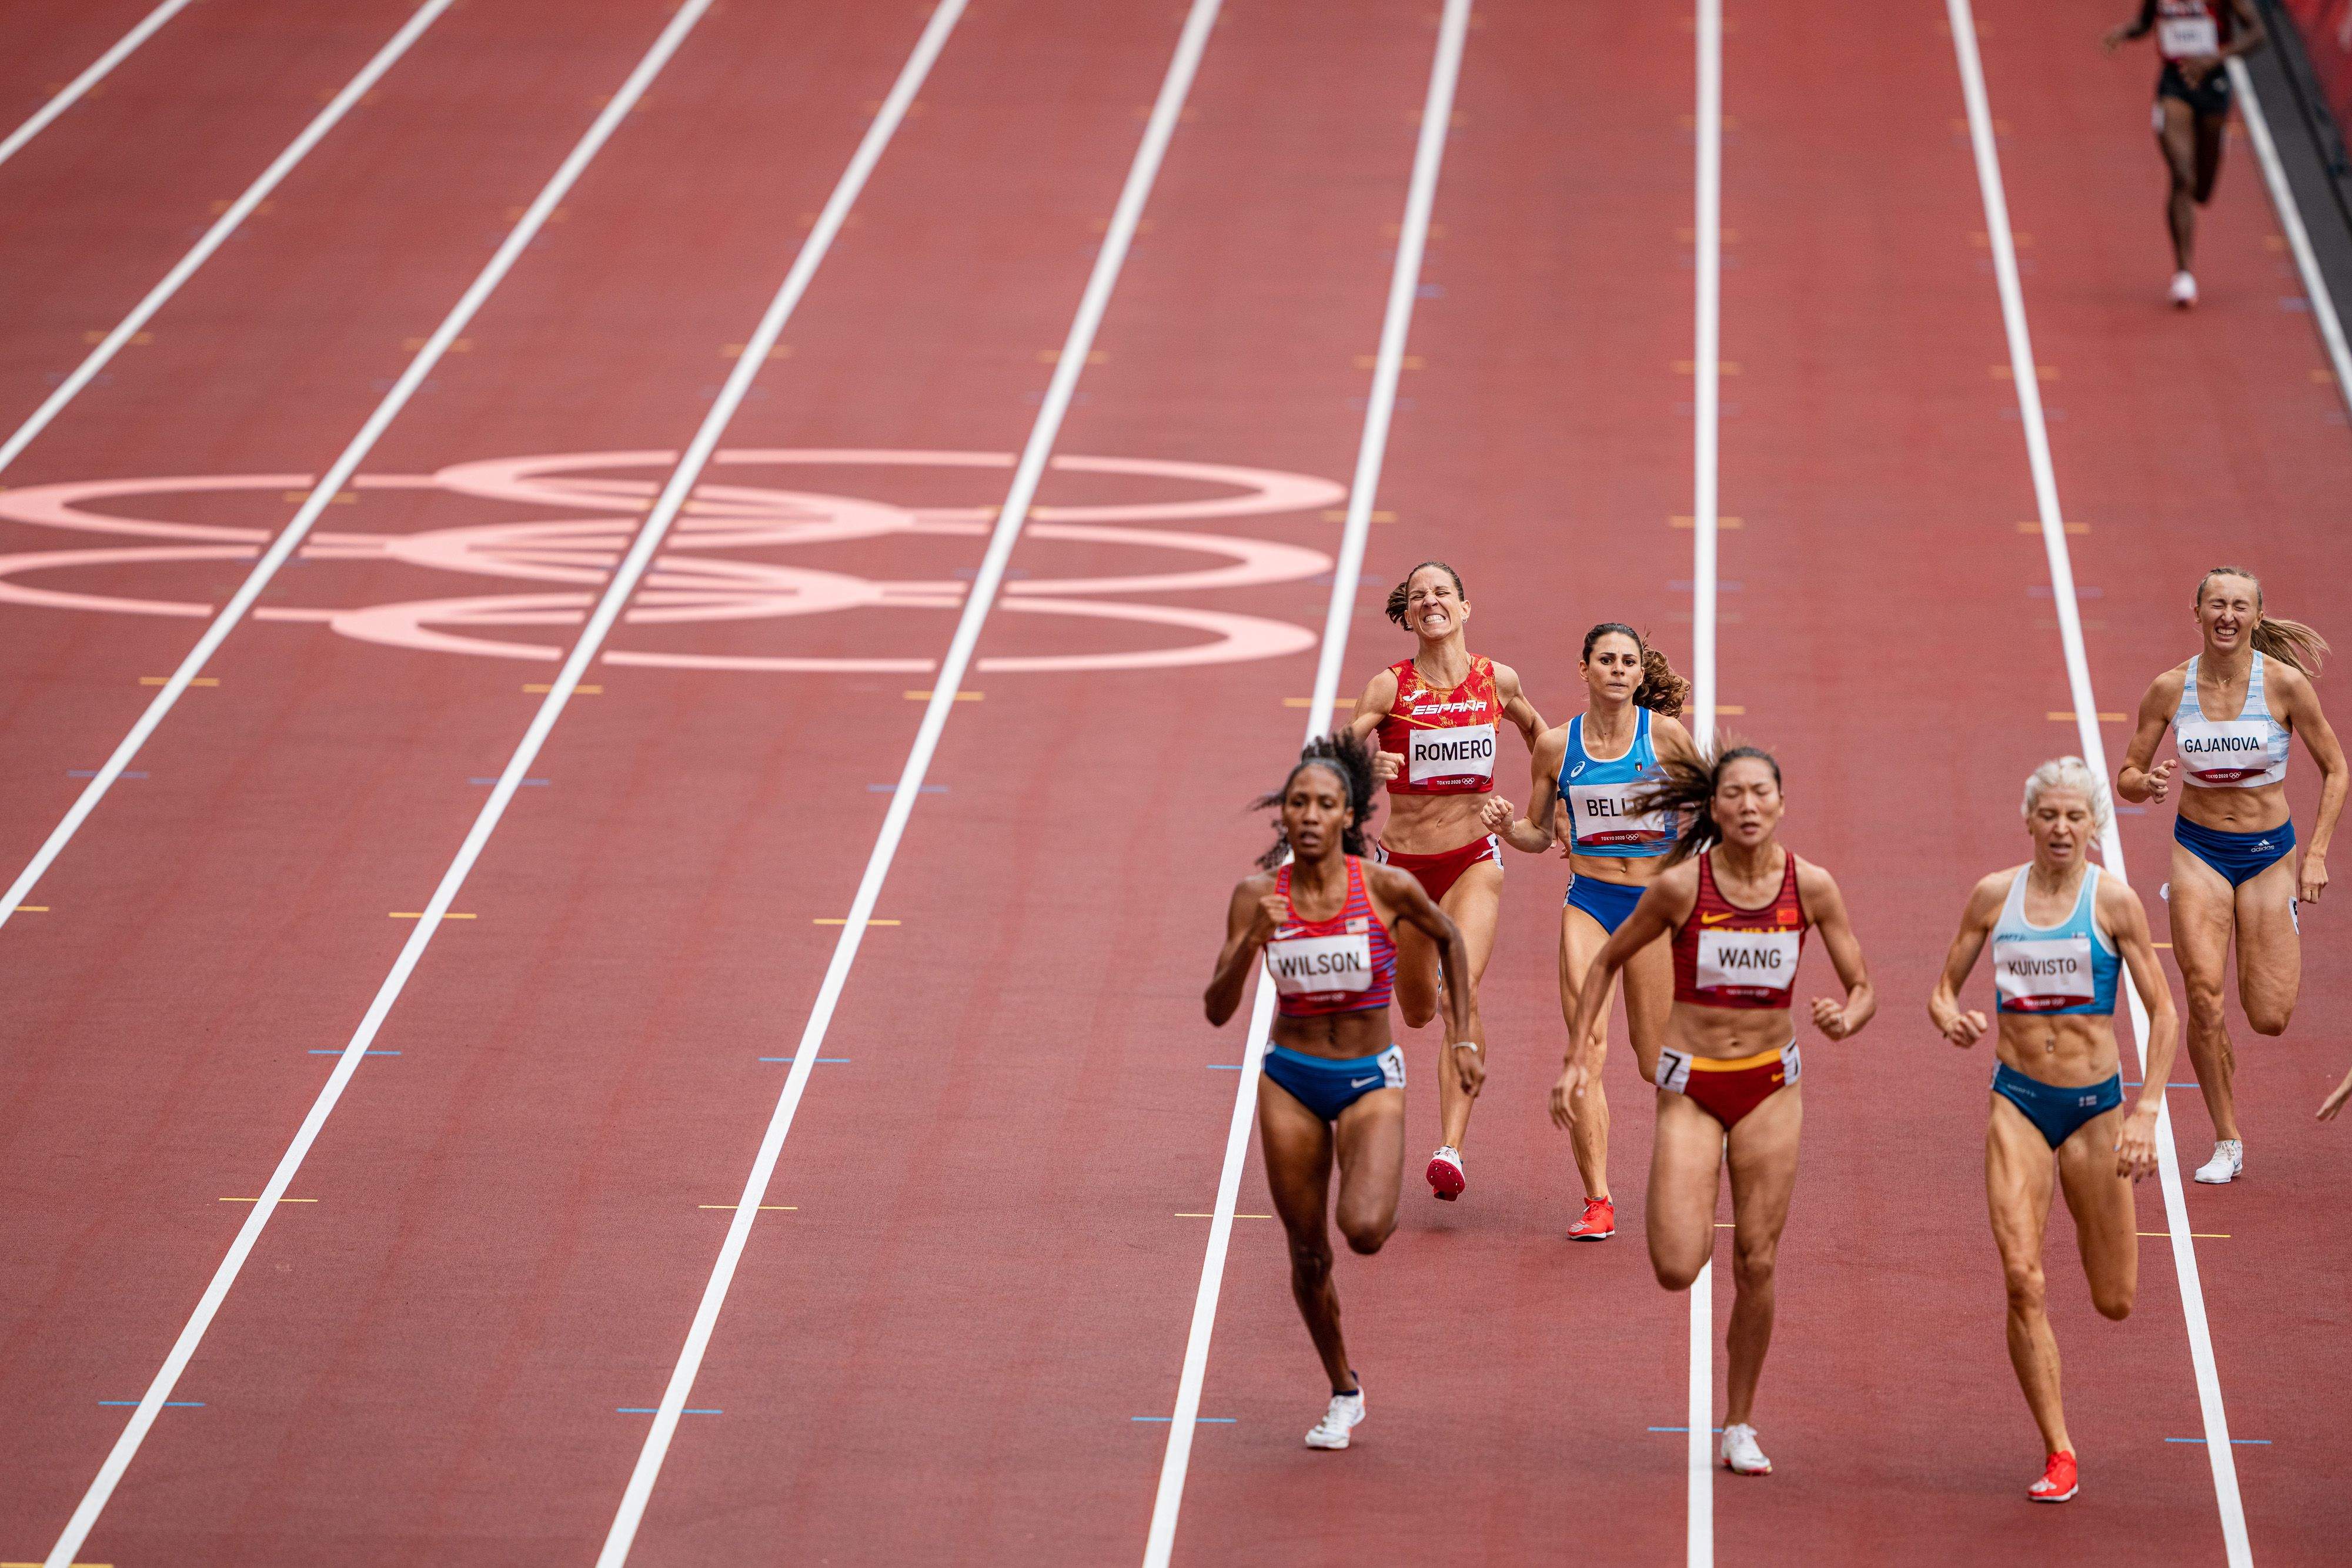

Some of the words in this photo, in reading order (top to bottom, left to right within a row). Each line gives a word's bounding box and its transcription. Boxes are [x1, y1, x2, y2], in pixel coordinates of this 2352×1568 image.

[1415, 738, 1492, 761] ROMERO
[2184, 737, 2260, 753] GAJANOVA
[1586, 798, 1641, 817] BELL
[1278, 951, 1360, 977] WILSON
[1718, 948, 1782, 969] WANG
[2008, 958, 2077, 976] KUIVISTO
[1663, 1052, 1682, 1085] 7
